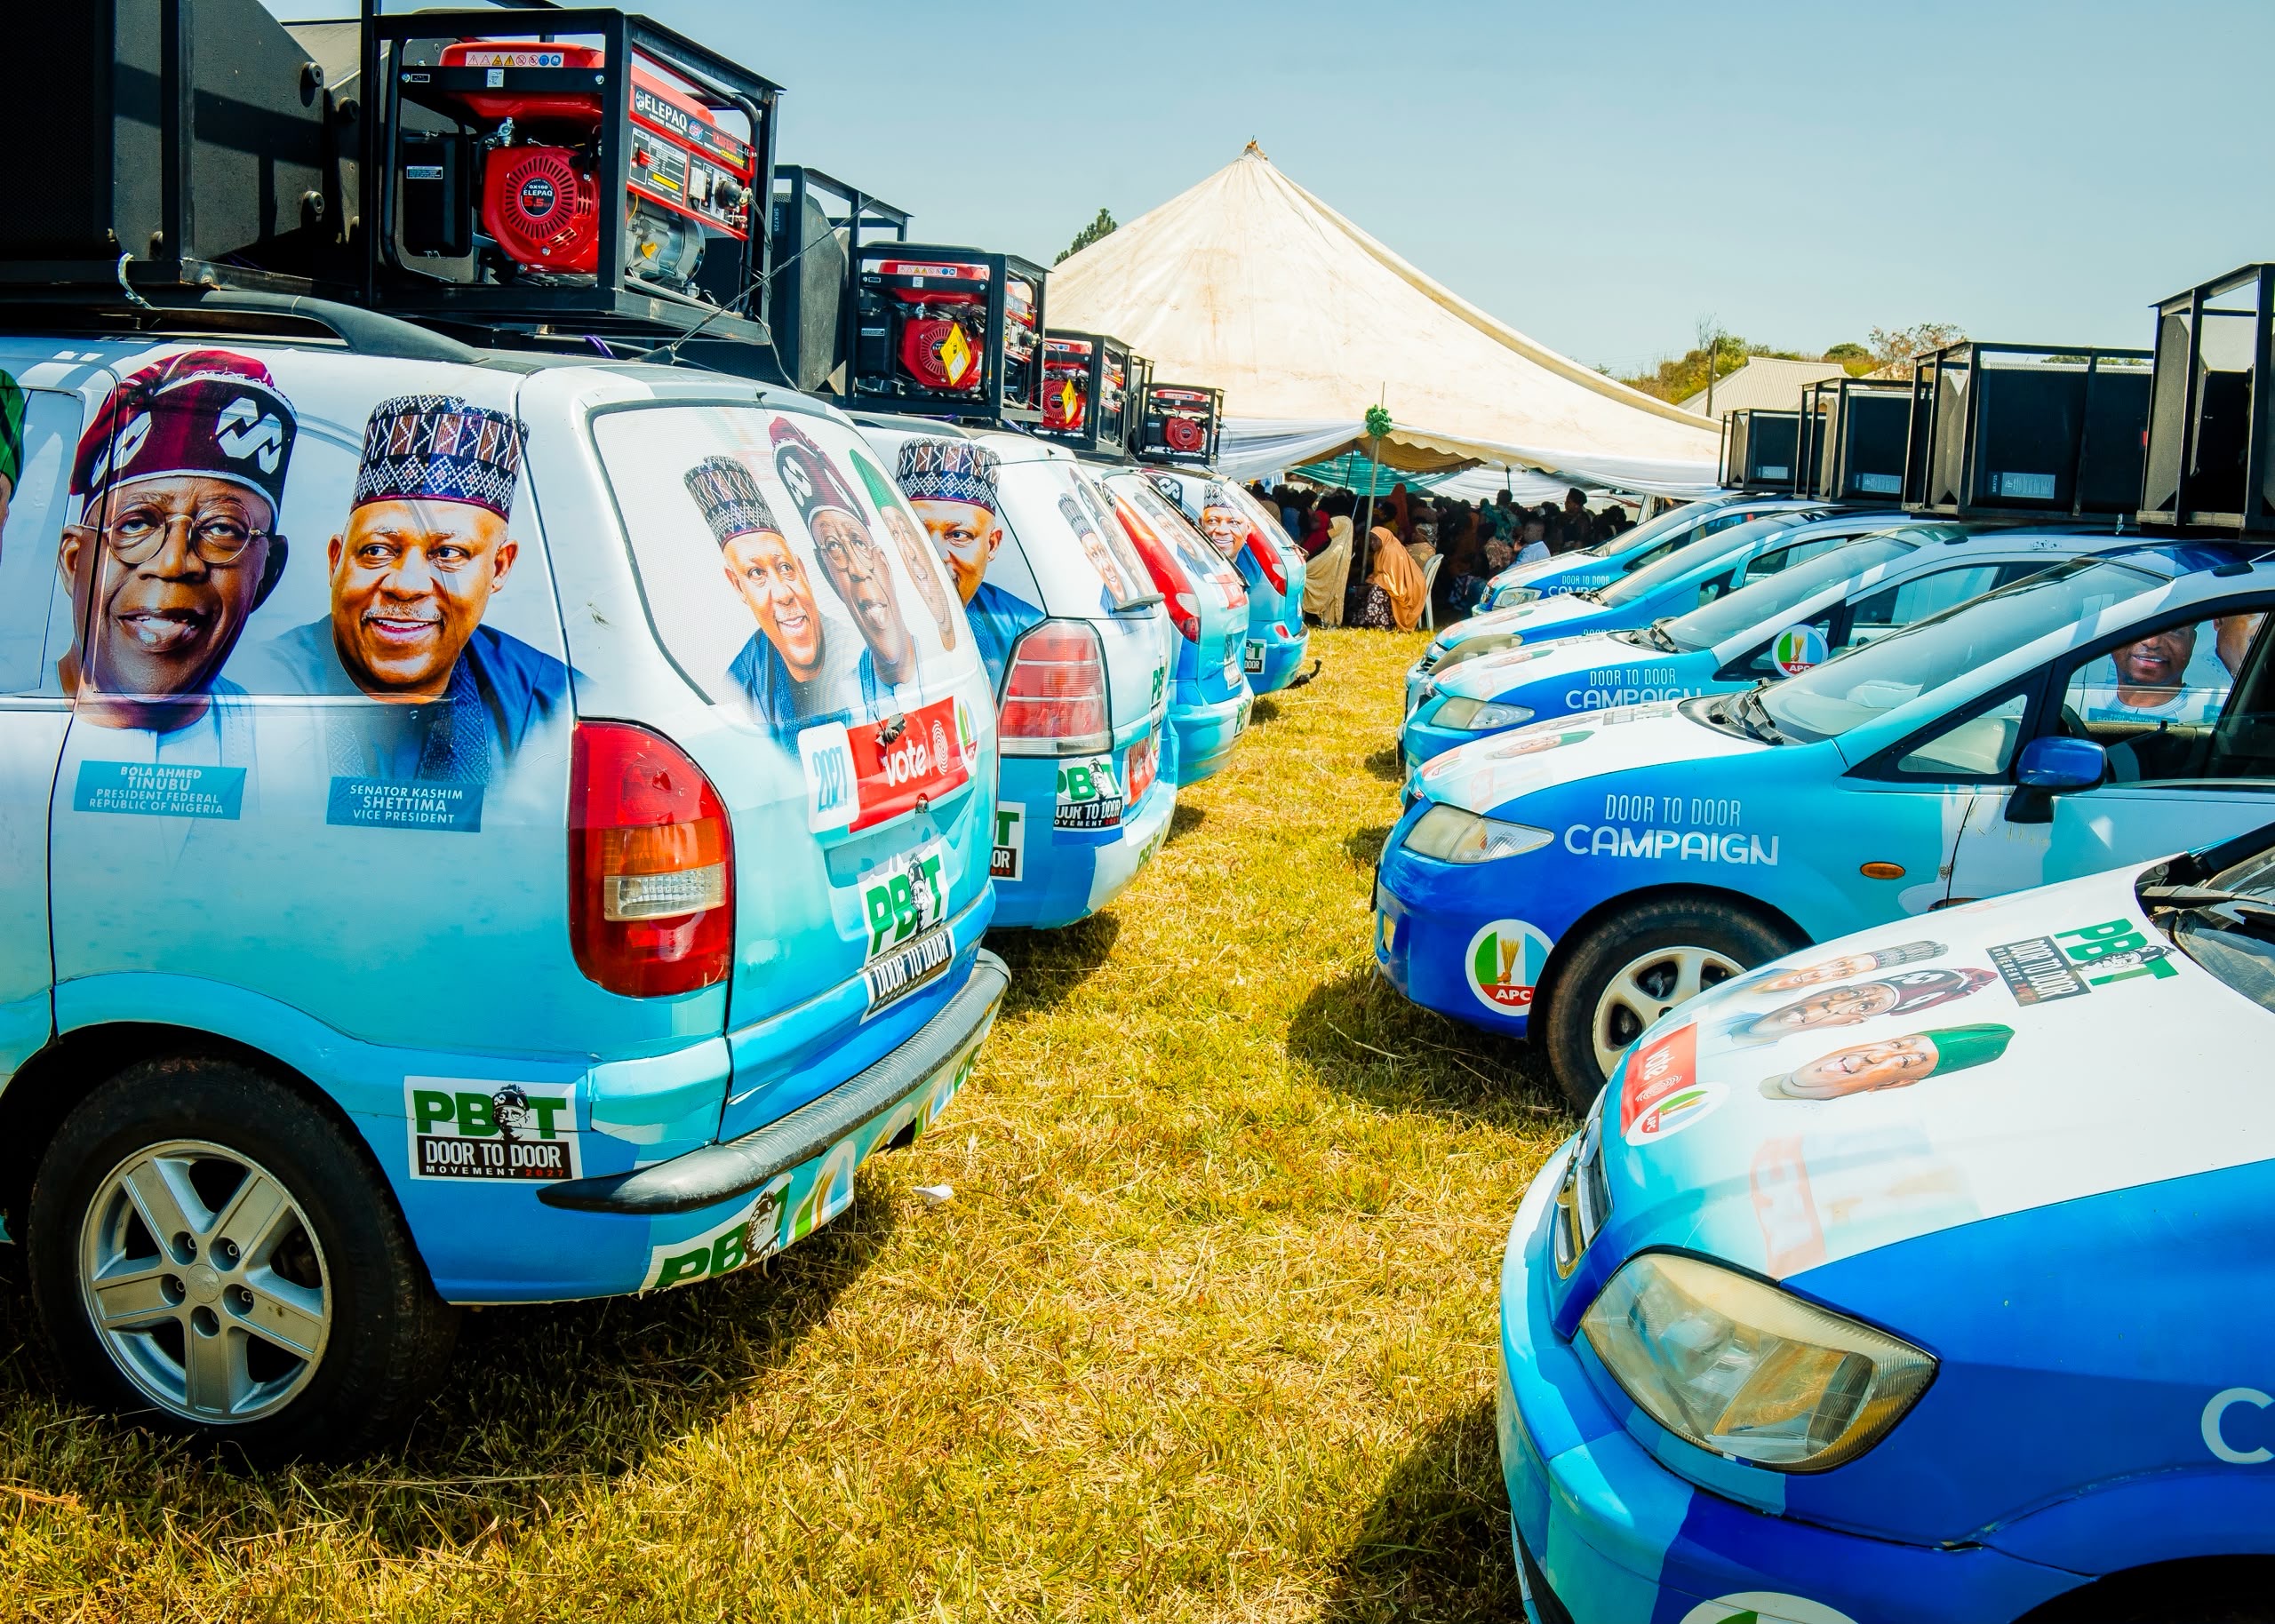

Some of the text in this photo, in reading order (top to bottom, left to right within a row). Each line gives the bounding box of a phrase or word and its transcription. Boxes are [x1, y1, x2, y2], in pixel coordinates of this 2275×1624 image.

[644, 93, 688, 132] ELEPAQ
[1562, 575, 1610, 585] DOOR TO DOOR
[1590, 668, 1676, 687] DOOR TO DOOR
[881, 736, 927, 787] vote
[120, 767, 202, 779] BOLA AHMED
[812, 745, 848, 813] 2027
[127, 776, 191, 791] TINUBU
[350, 785, 463, 800] SENATOR KASHIM
[96, 789, 219, 804] PRESIDENT FEDERAL
[363, 796, 446, 812] SHETTIMA
[89, 799, 223, 814] REPUBLIC OF NIGERIA
[1084, 803, 1099, 819] TO
[1101, 799, 1121, 819] DOOR
[1605, 793, 1741, 827] DOOR TO DOOR
[353, 809, 455, 824] VICE PRESIDENT
[1564, 824, 1779, 866] CAMPAIGN
[873, 954, 907, 998] DOOR
[922, 932, 949, 971] DOOR
[1992, 947, 2023, 981] MOVEMENT
[2008, 939, 2079, 999] DOOR TO DOOR
[1495, 989, 1530, 1001] APC
[1643, 1045, 1675, 1080] vote
[425, 1140, 563, 1168] DOOR TO DOOR
[426, 1166, 564, 1177] MOVEMENT 2027
